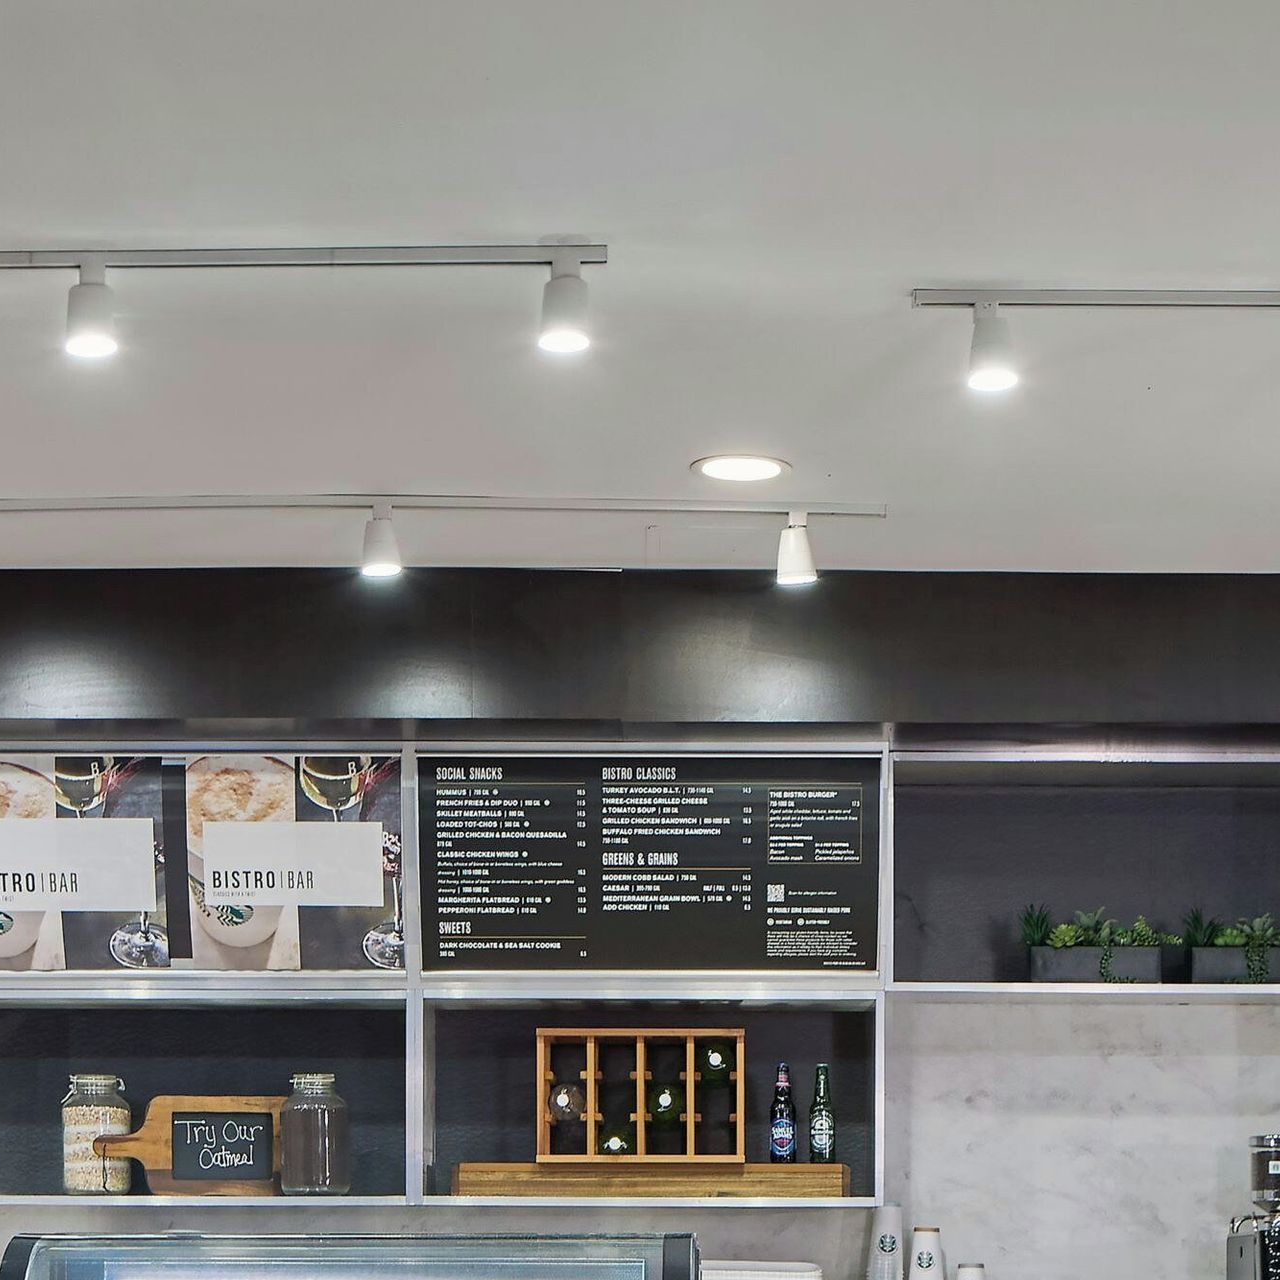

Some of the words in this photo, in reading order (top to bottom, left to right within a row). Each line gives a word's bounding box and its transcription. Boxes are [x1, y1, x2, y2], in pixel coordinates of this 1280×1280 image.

[436, 767, 466, 780] SOCIAL
[469, 767, 503, 780] SNACKS
[602, 767, 633, 780] BISTRO
[636, 767, 676, 780] CLASSICS
[602, 797, 651, 805] THREE-CHEESE
[653, 797, 680, 805] GRILLED
[681, 797, 708, 805] CHEESE
[602, 817, 630, 825] GRILLED
[630, 817, 660, 825] CHICKEN
[661, 817, 697, 825] SANDWICH
[602, 853, 634, 865] GREENS
[637, 853, 645, 865] &
[648, 853, 678, 865] GRAINS
[49, 873, 78, 892] BAR
[212, 871, 275, 889] BISTRO
[288, 871, 314, 889] BAR
[602, 884, 629, 892] CAESAR
[439, 922, 471, 934] SWEETS
[174, 1120, 218, 1149] Try
[222, 1120, 264, 1143] Our
[199, 1145, 255, 1170] Oatmeal
